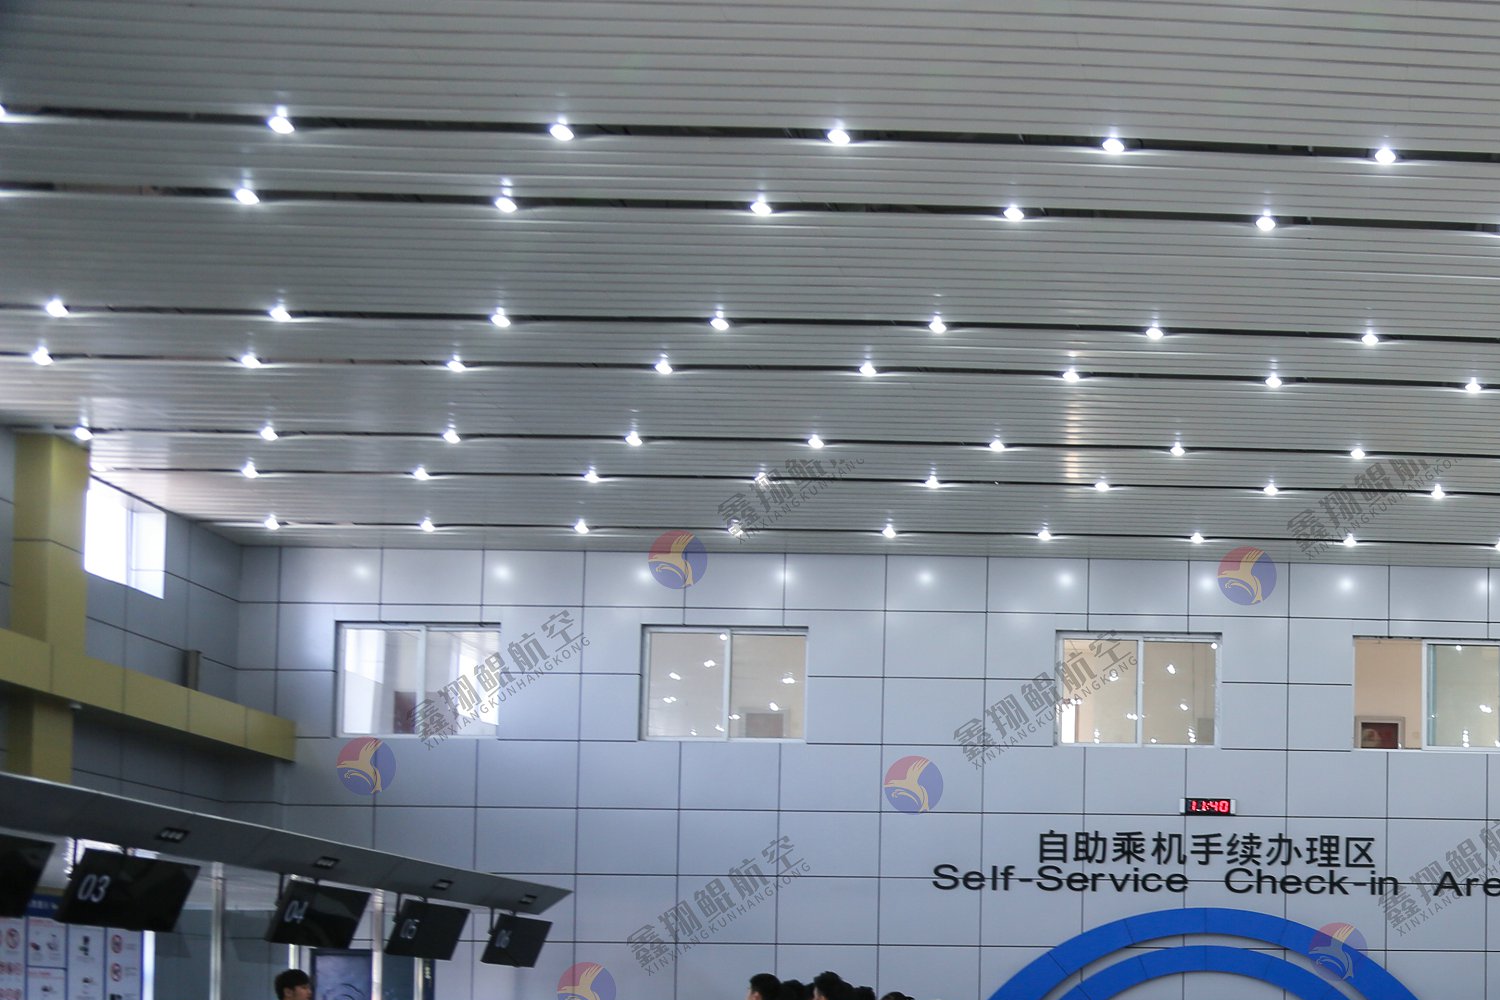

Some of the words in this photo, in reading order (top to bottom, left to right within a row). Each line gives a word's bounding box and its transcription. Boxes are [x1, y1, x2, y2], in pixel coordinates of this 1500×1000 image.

[1038, 830, 1377, 869] 自助乘机手续办理区
[77, 873, 111, 903] 03
[932, 863, 1189, 894] Self-Service
[1225, 866, 1399, 896] Check-in
[283, 899, 309, 924] 04
